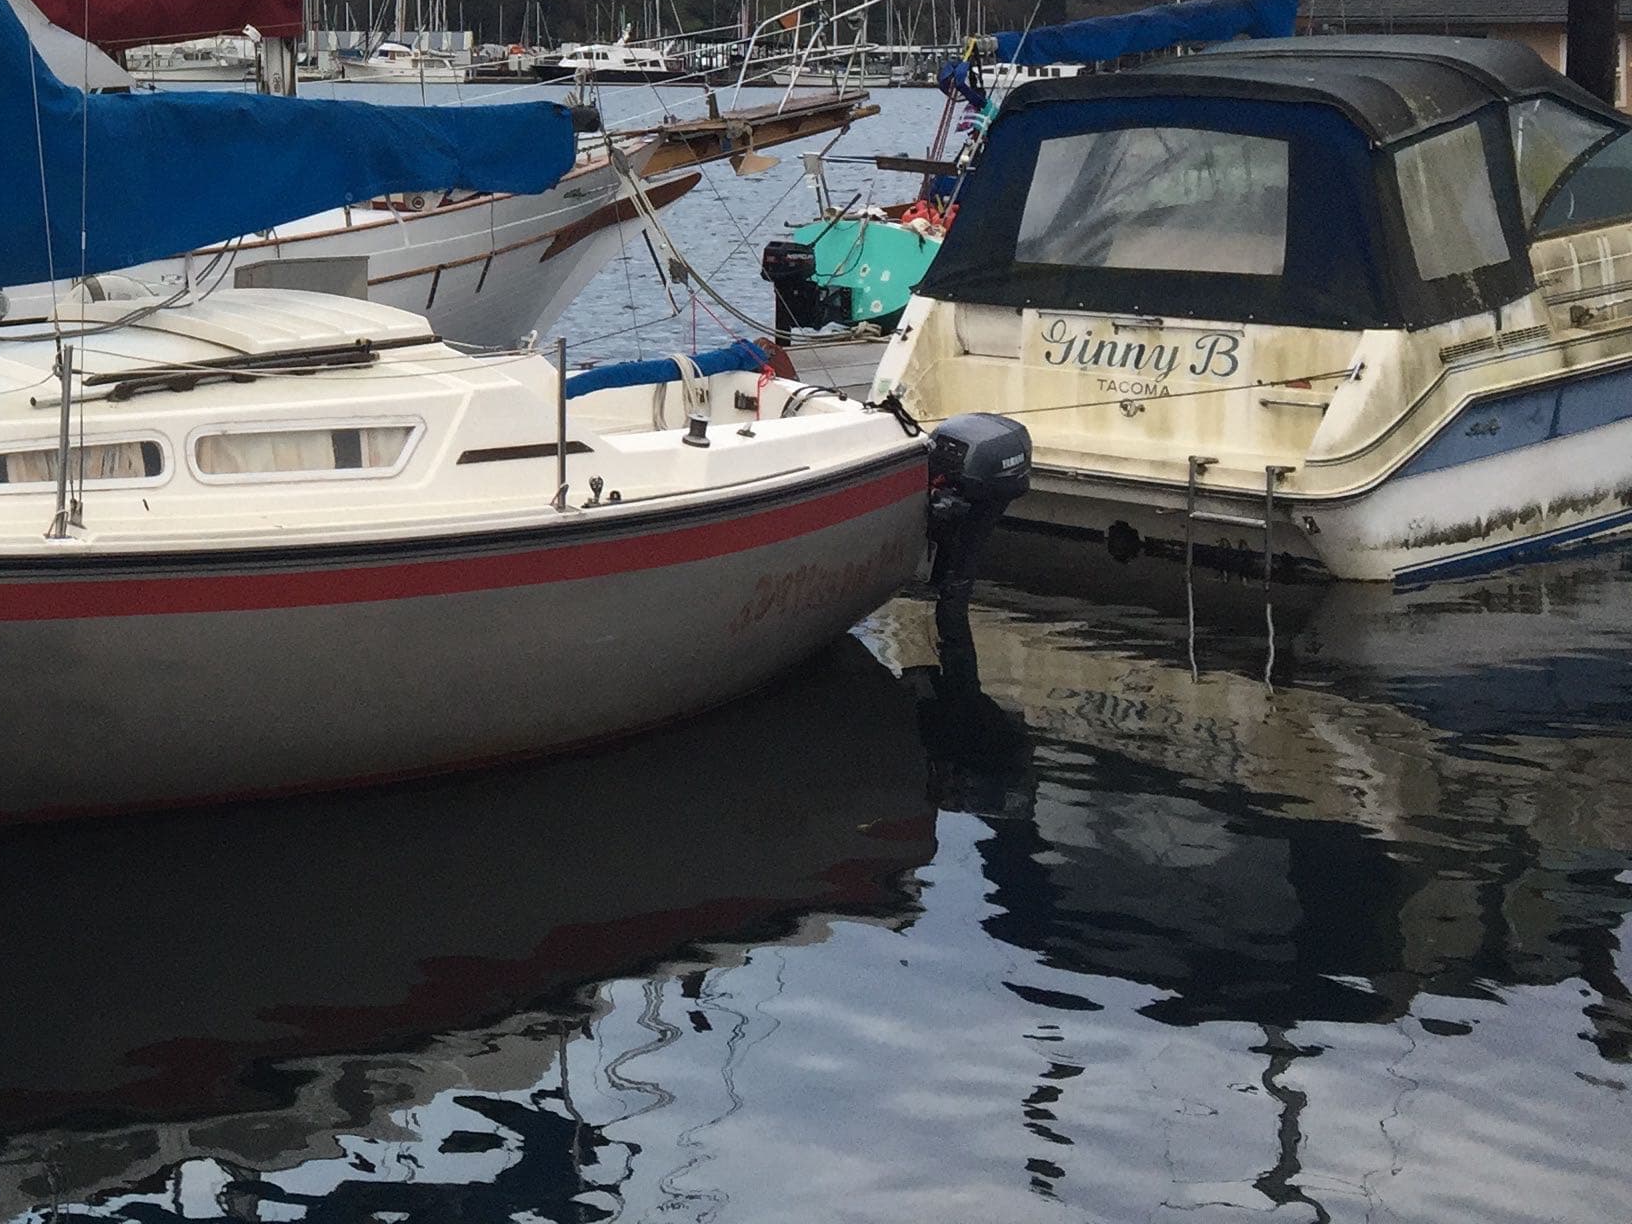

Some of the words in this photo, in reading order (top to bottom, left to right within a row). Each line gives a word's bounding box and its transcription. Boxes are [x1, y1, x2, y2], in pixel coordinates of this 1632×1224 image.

[1041, 319, 1181, 382] Ginny
[1189, 333, 1240, 377] B
[1097, 378, 1170, 397] TACOMA
